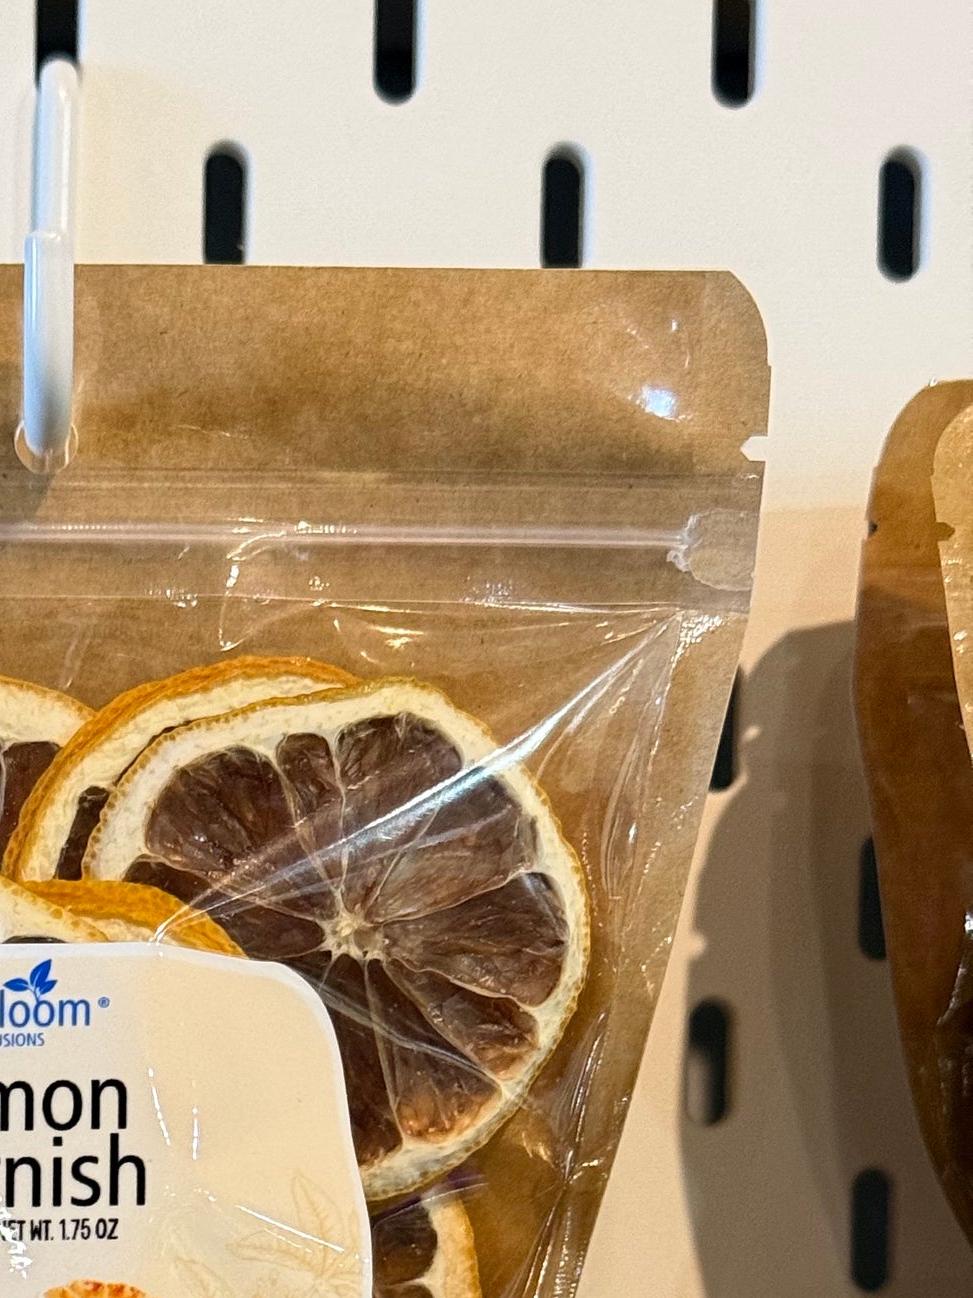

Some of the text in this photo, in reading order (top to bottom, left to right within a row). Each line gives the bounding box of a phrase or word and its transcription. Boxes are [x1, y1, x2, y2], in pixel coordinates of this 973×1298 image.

[30, 1219, 54, 1241] WT.
[59, 1218, 91, 1241] 1.75
[95, 1218, 119, 1239] OZ
